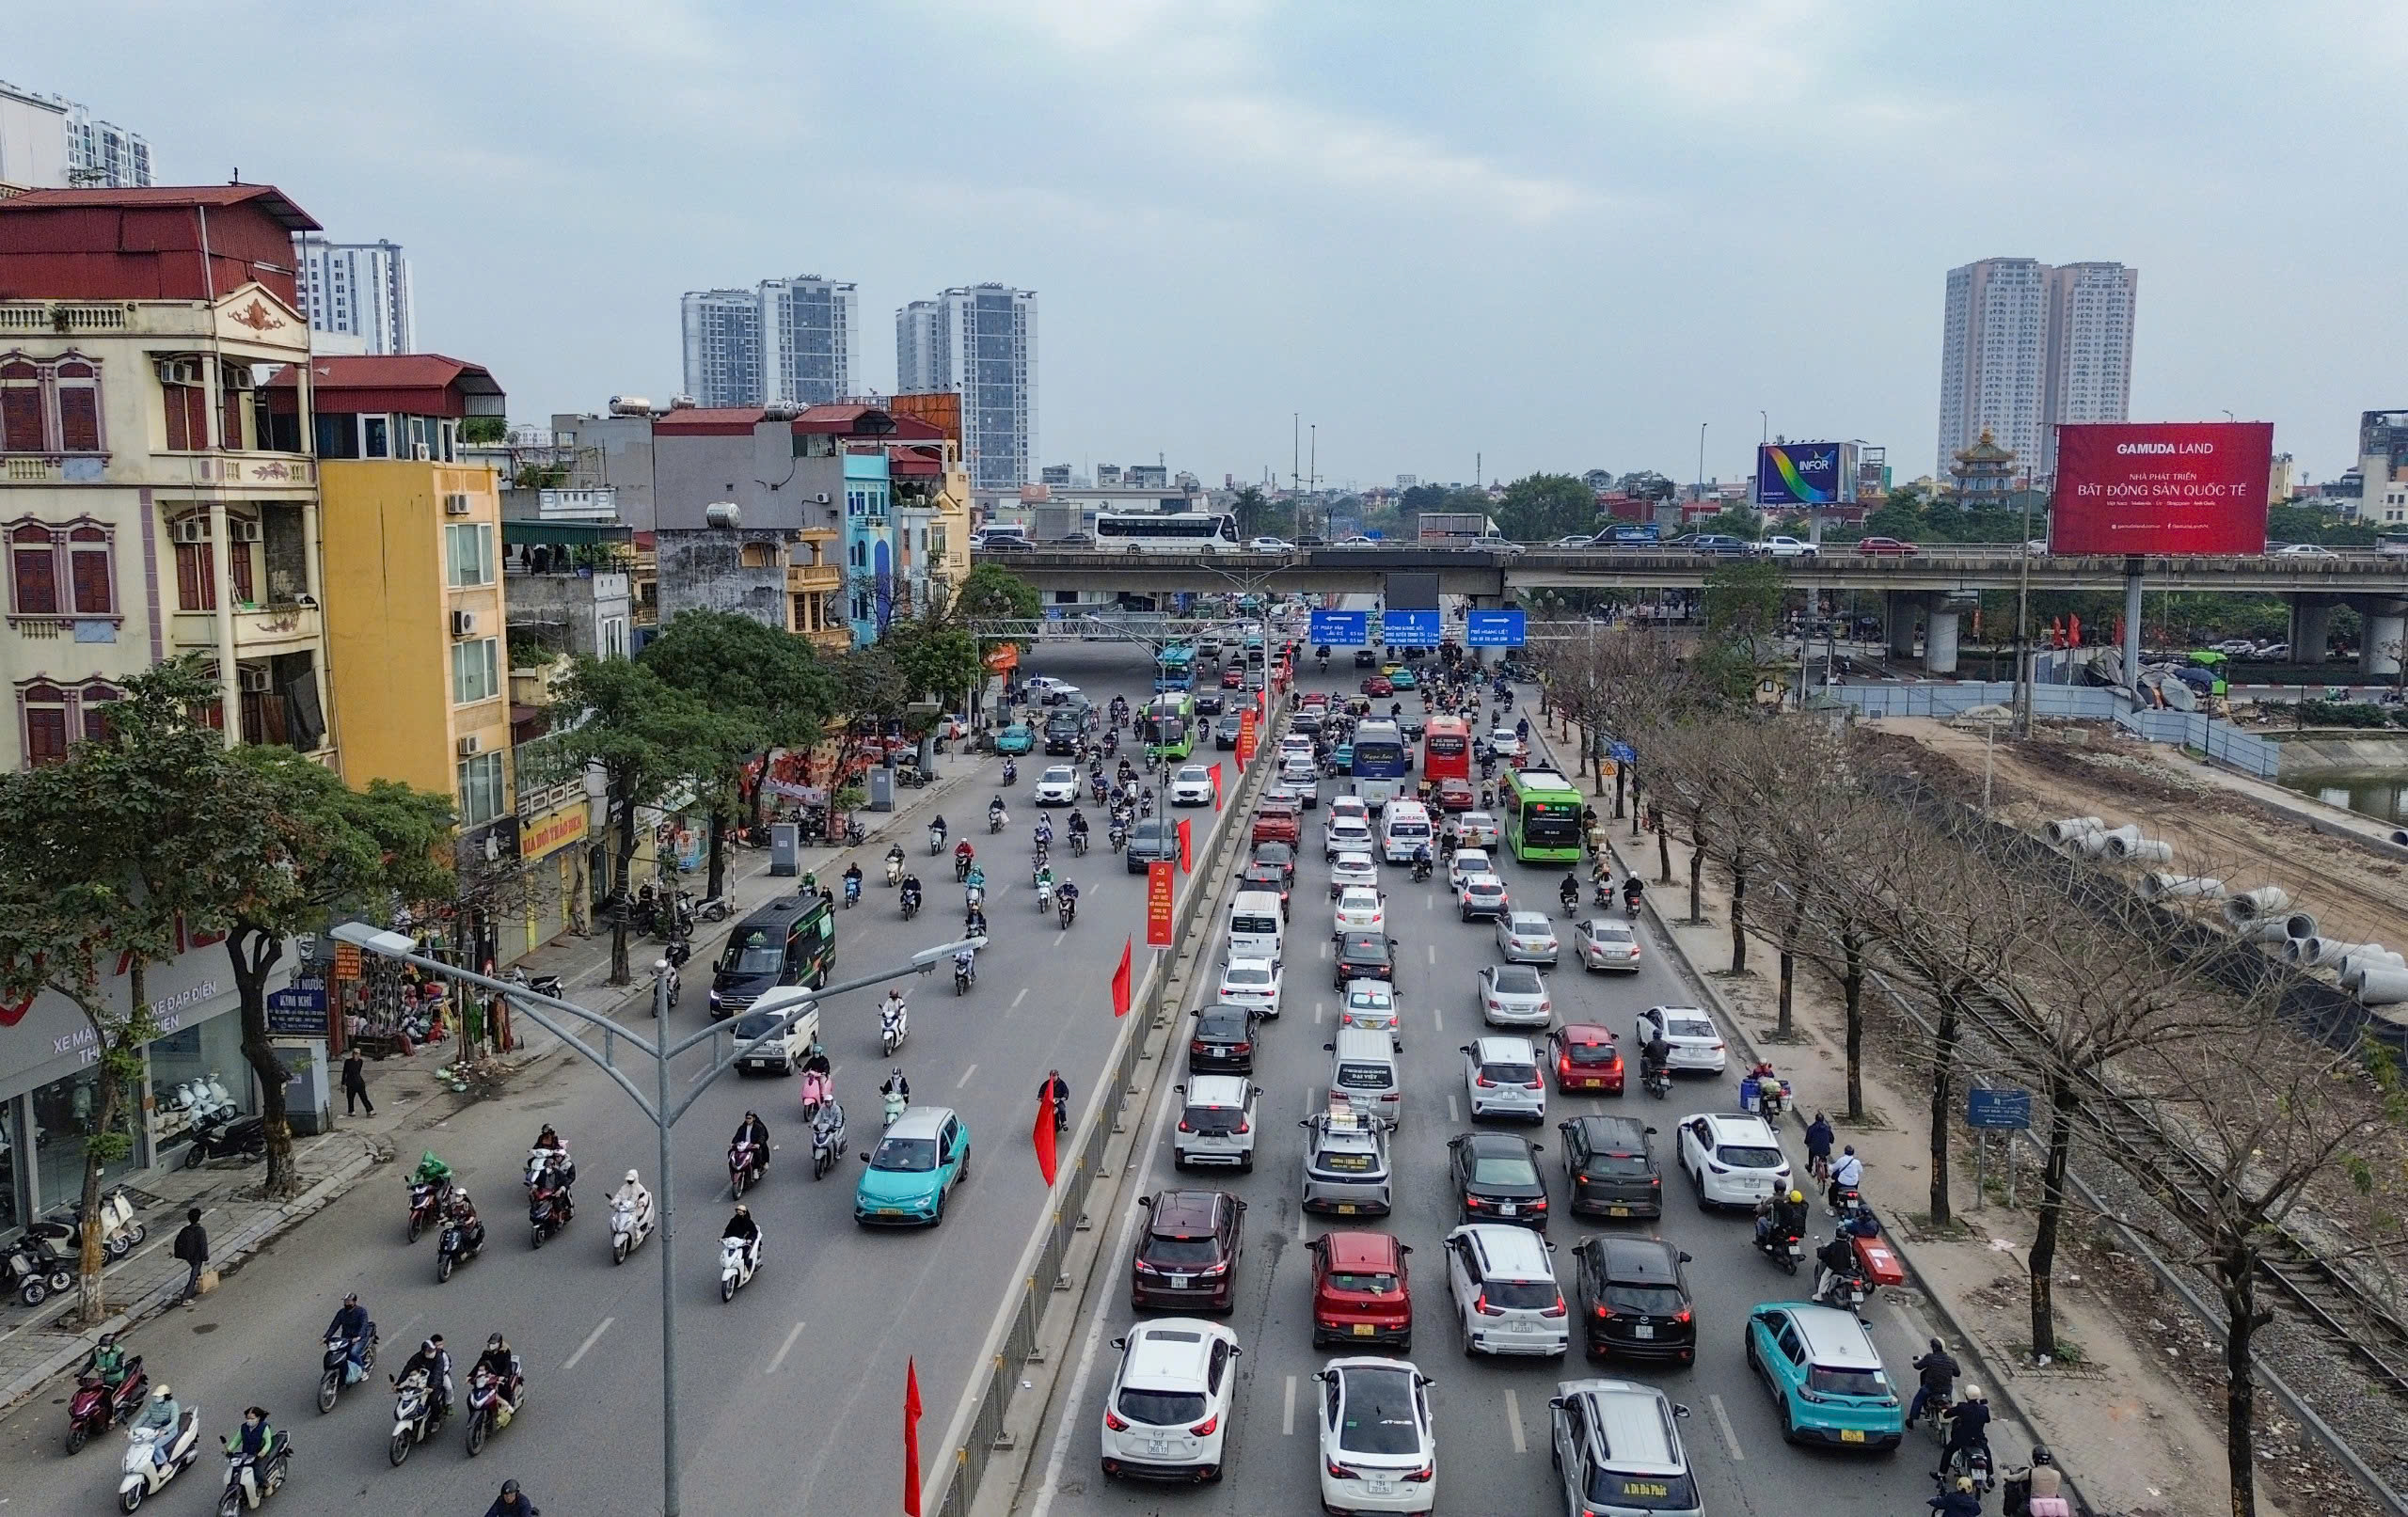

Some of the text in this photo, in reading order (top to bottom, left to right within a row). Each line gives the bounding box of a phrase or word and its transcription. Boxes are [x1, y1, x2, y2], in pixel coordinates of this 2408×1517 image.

[2116, 443, 2213, 454] GAMUDA LAND
[2130, 470, 2196, 481] NHÀ PHÁT TRIỂN
[2078, 482, 2246, 498] BẤT ĐỘNG SẢN QUỐC TẾ
[302, 975, 324, 990] NƯỚC
[280, 993, 312, 1006] KIM KHÍ
[53, 1035, 70, 1054] XE
[150, 1000, 165, 1018] XE
[166, 992, 189, 1012] ĐẠP
[191, 980, 216, 1002] ĐIỆN
